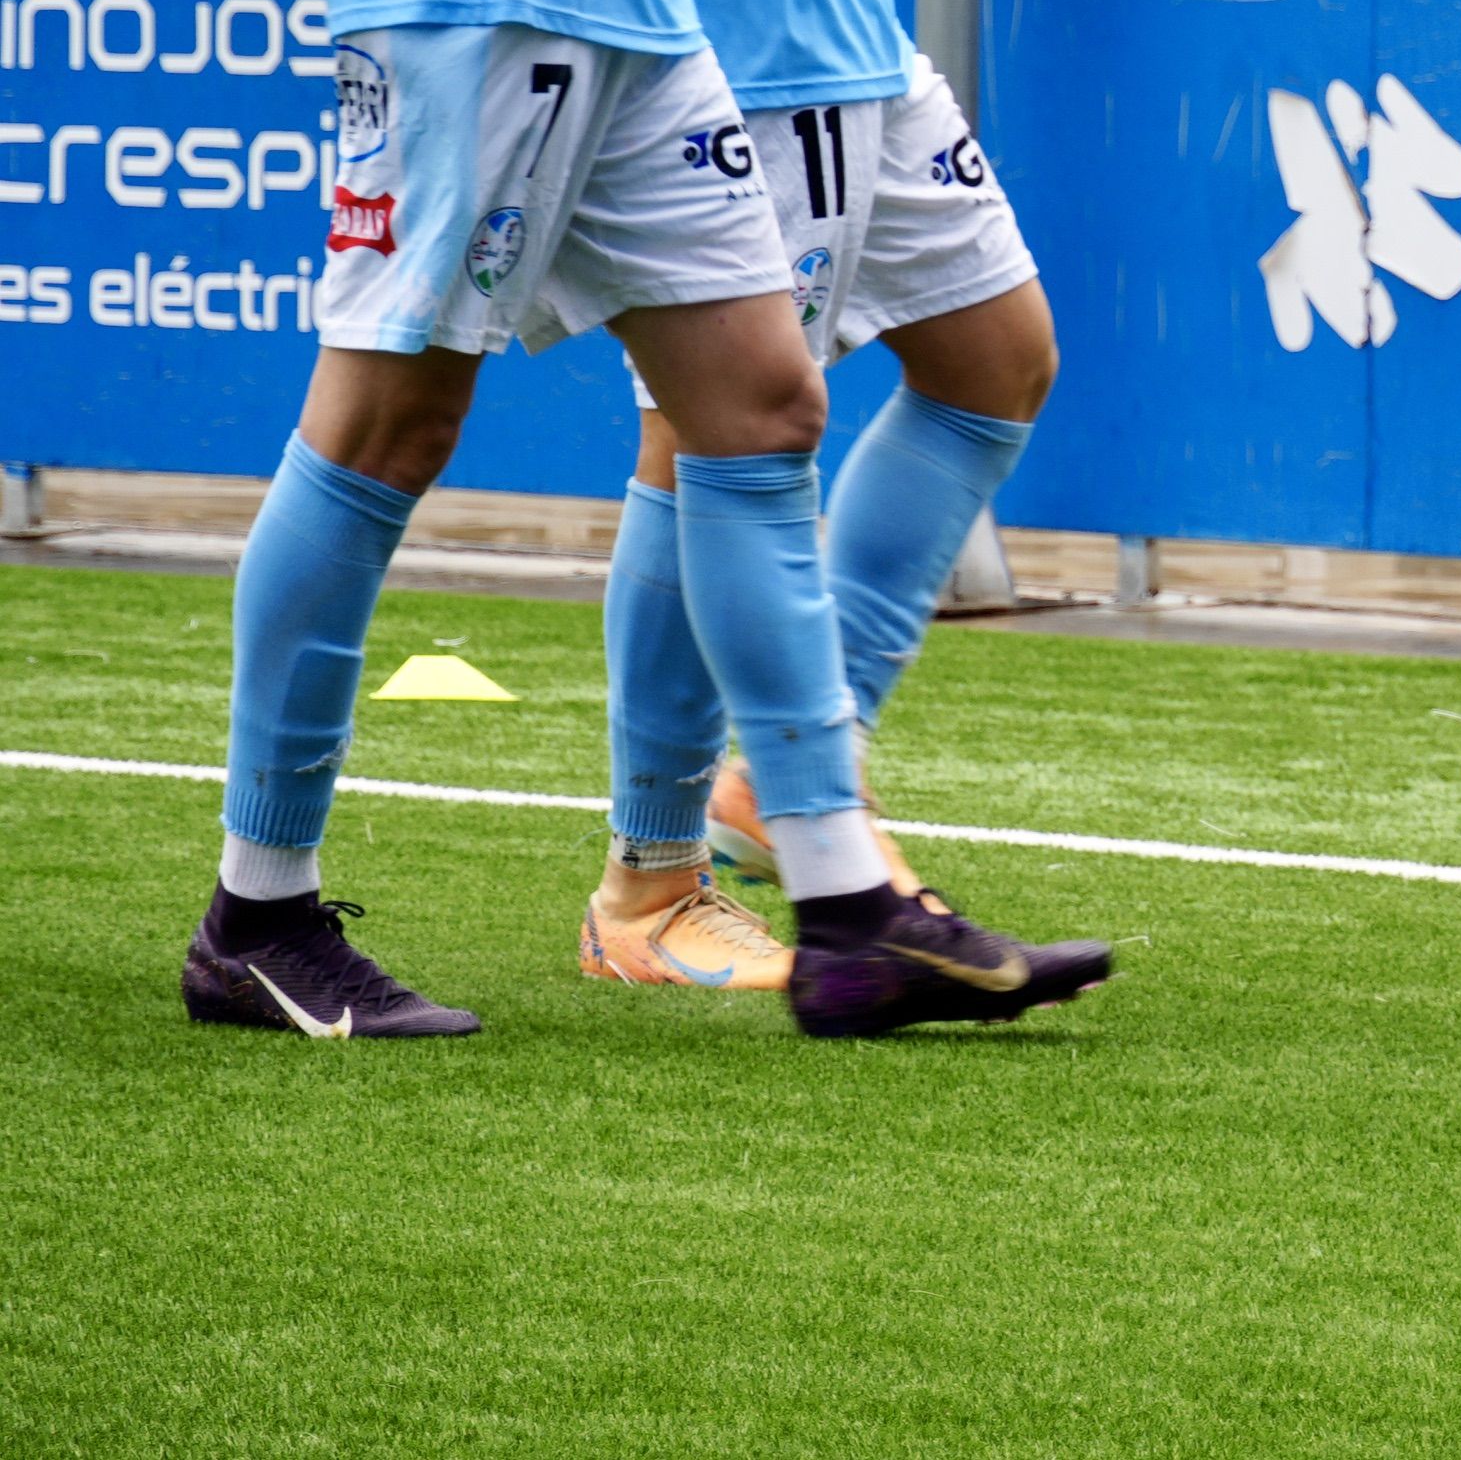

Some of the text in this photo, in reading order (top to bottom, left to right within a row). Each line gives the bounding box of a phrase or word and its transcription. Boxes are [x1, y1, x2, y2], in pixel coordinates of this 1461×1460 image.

[530, 62, 573, 179] 7
[792, 105, 846, 220] 11
[88, 251, 332, 333] eléctri
